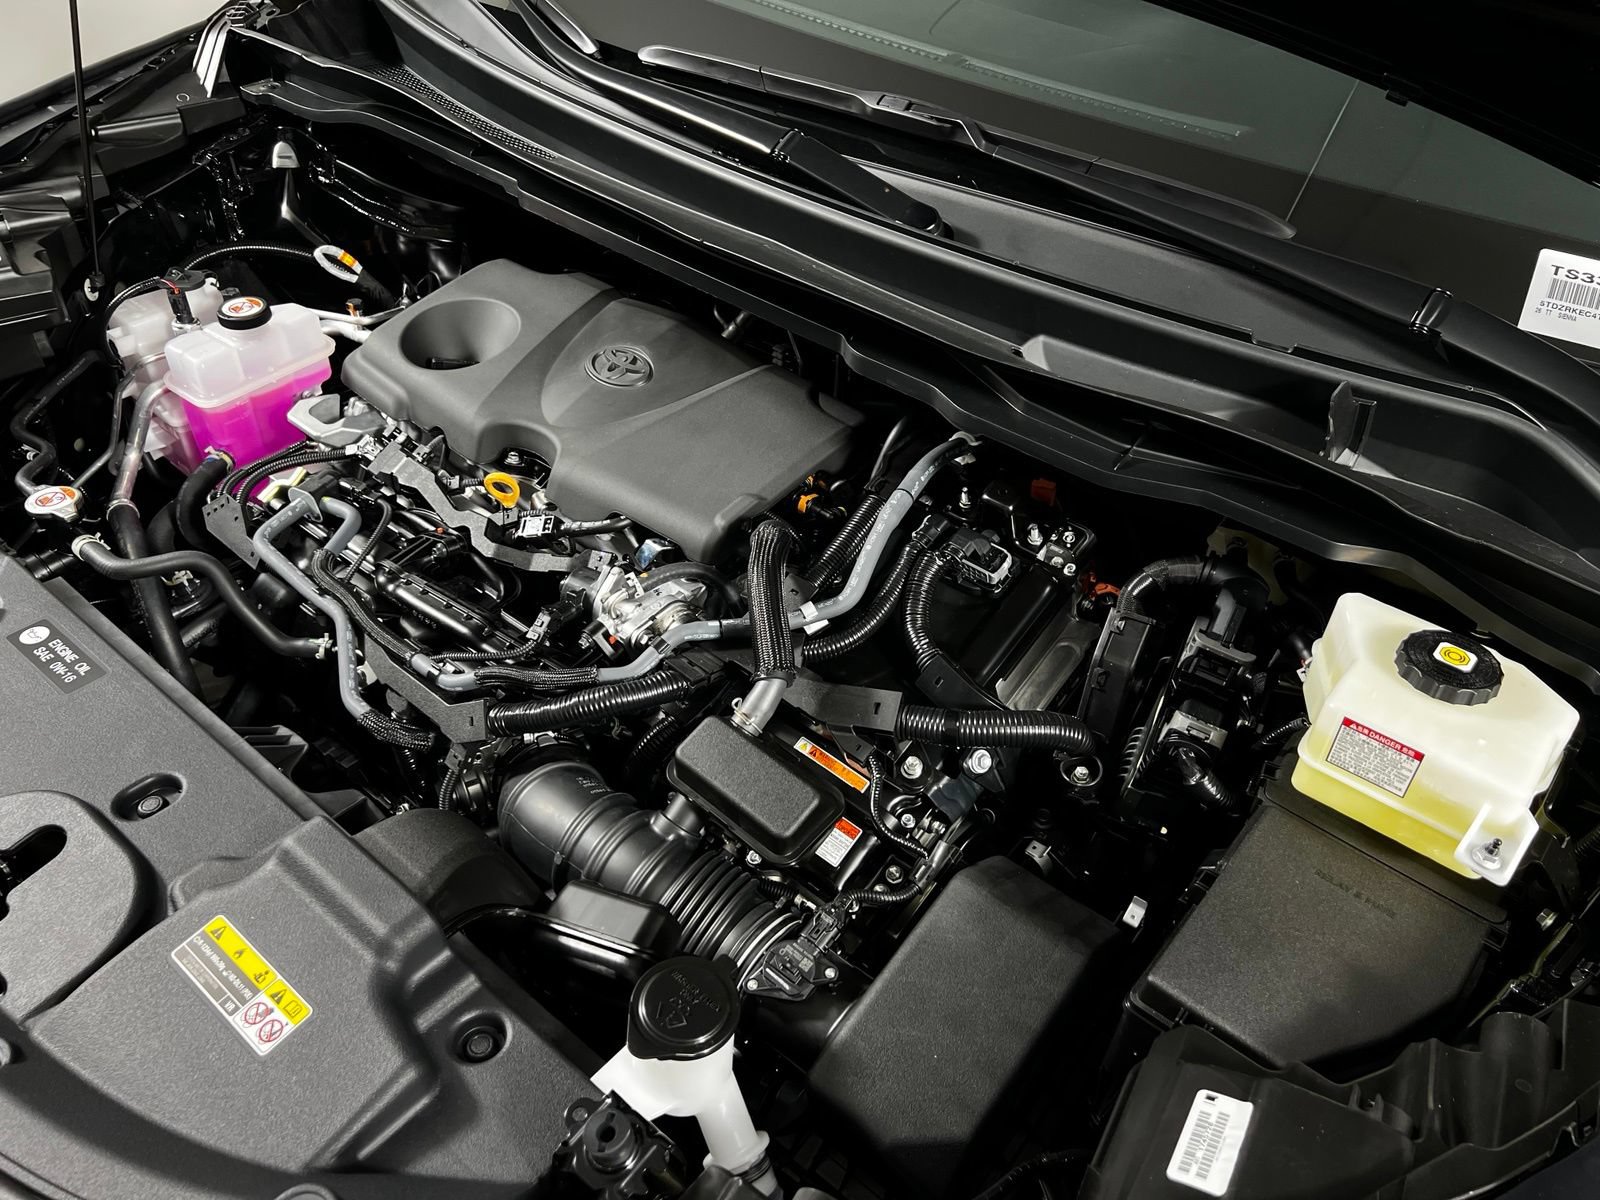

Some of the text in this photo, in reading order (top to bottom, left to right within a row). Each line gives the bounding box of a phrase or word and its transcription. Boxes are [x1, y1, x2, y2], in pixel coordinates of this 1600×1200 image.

[1539, 300, 1600, 320] 5TDZRKEC4
[33, 646, 77, 683] SAE 0W-16
[48, 638, 91, 676] ENGINE OIL
[1369, 731, 1401, 750] DANGER
[223, 1000, 236, 1012] VR
